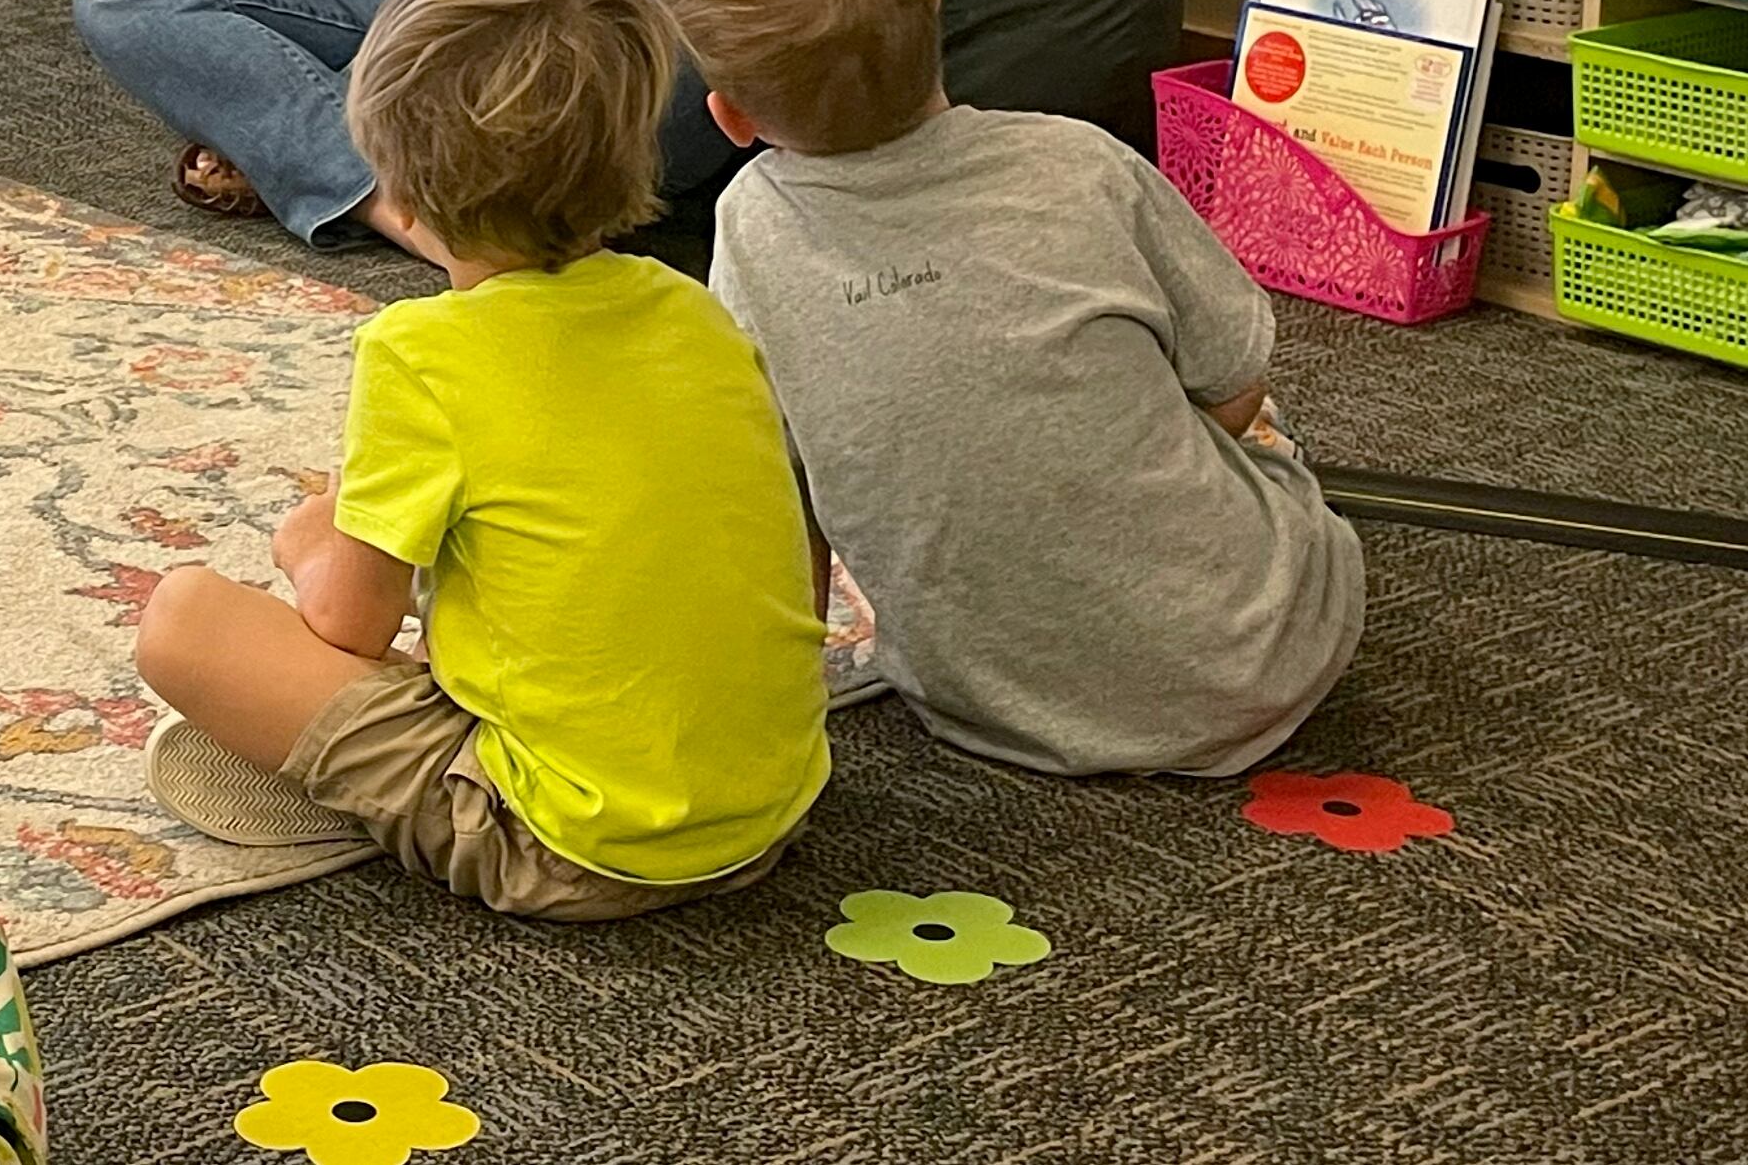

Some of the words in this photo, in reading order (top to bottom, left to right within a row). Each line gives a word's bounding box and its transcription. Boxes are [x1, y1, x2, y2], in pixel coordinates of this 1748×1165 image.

[1293, 128, 1317, 142] and
[1321, 131, 1355, 150] Value
[1358, 139, 1387, 158] Each
[1390, 148, 1434, 171] Person
[843, 276, 871, 305] Vail
[878, 260, 942, 296] Colorado
